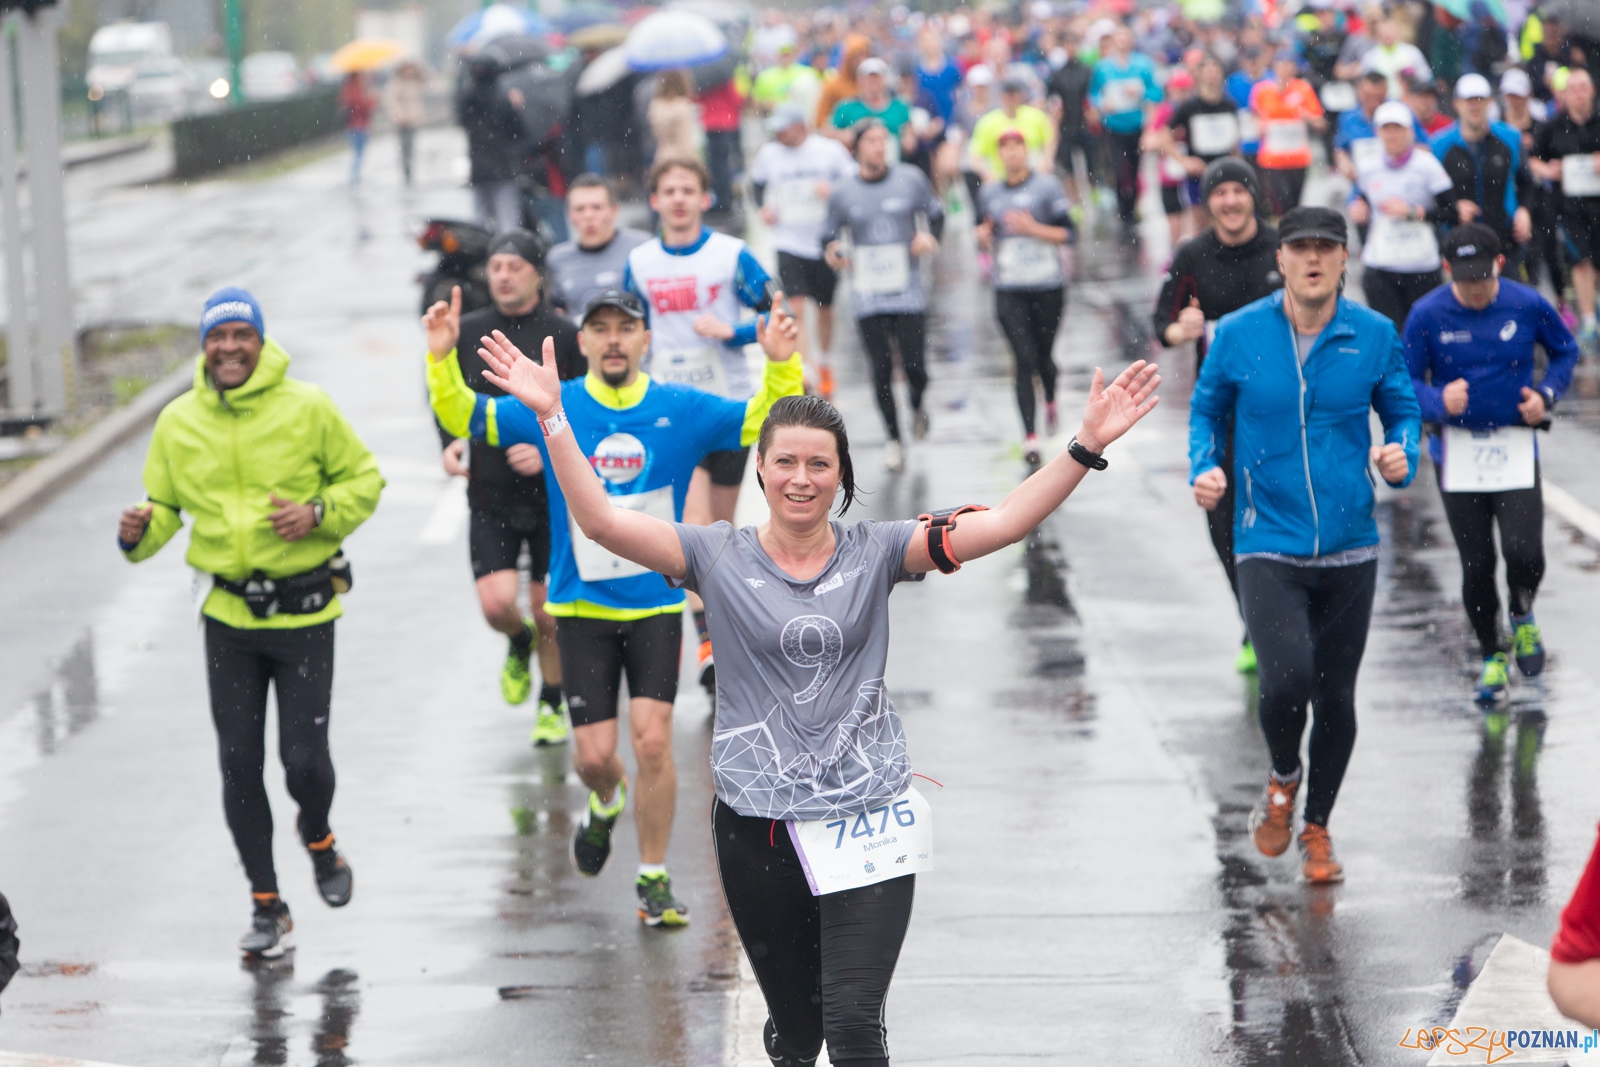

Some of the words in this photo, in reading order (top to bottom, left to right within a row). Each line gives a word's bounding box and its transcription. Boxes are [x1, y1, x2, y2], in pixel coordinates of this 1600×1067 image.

[1473, 446, 1508, 464] 775
[779, 614, 844, 705] 9
[825, 799, 915, 850] 7476
[863, 836, 898, 852] Monika
